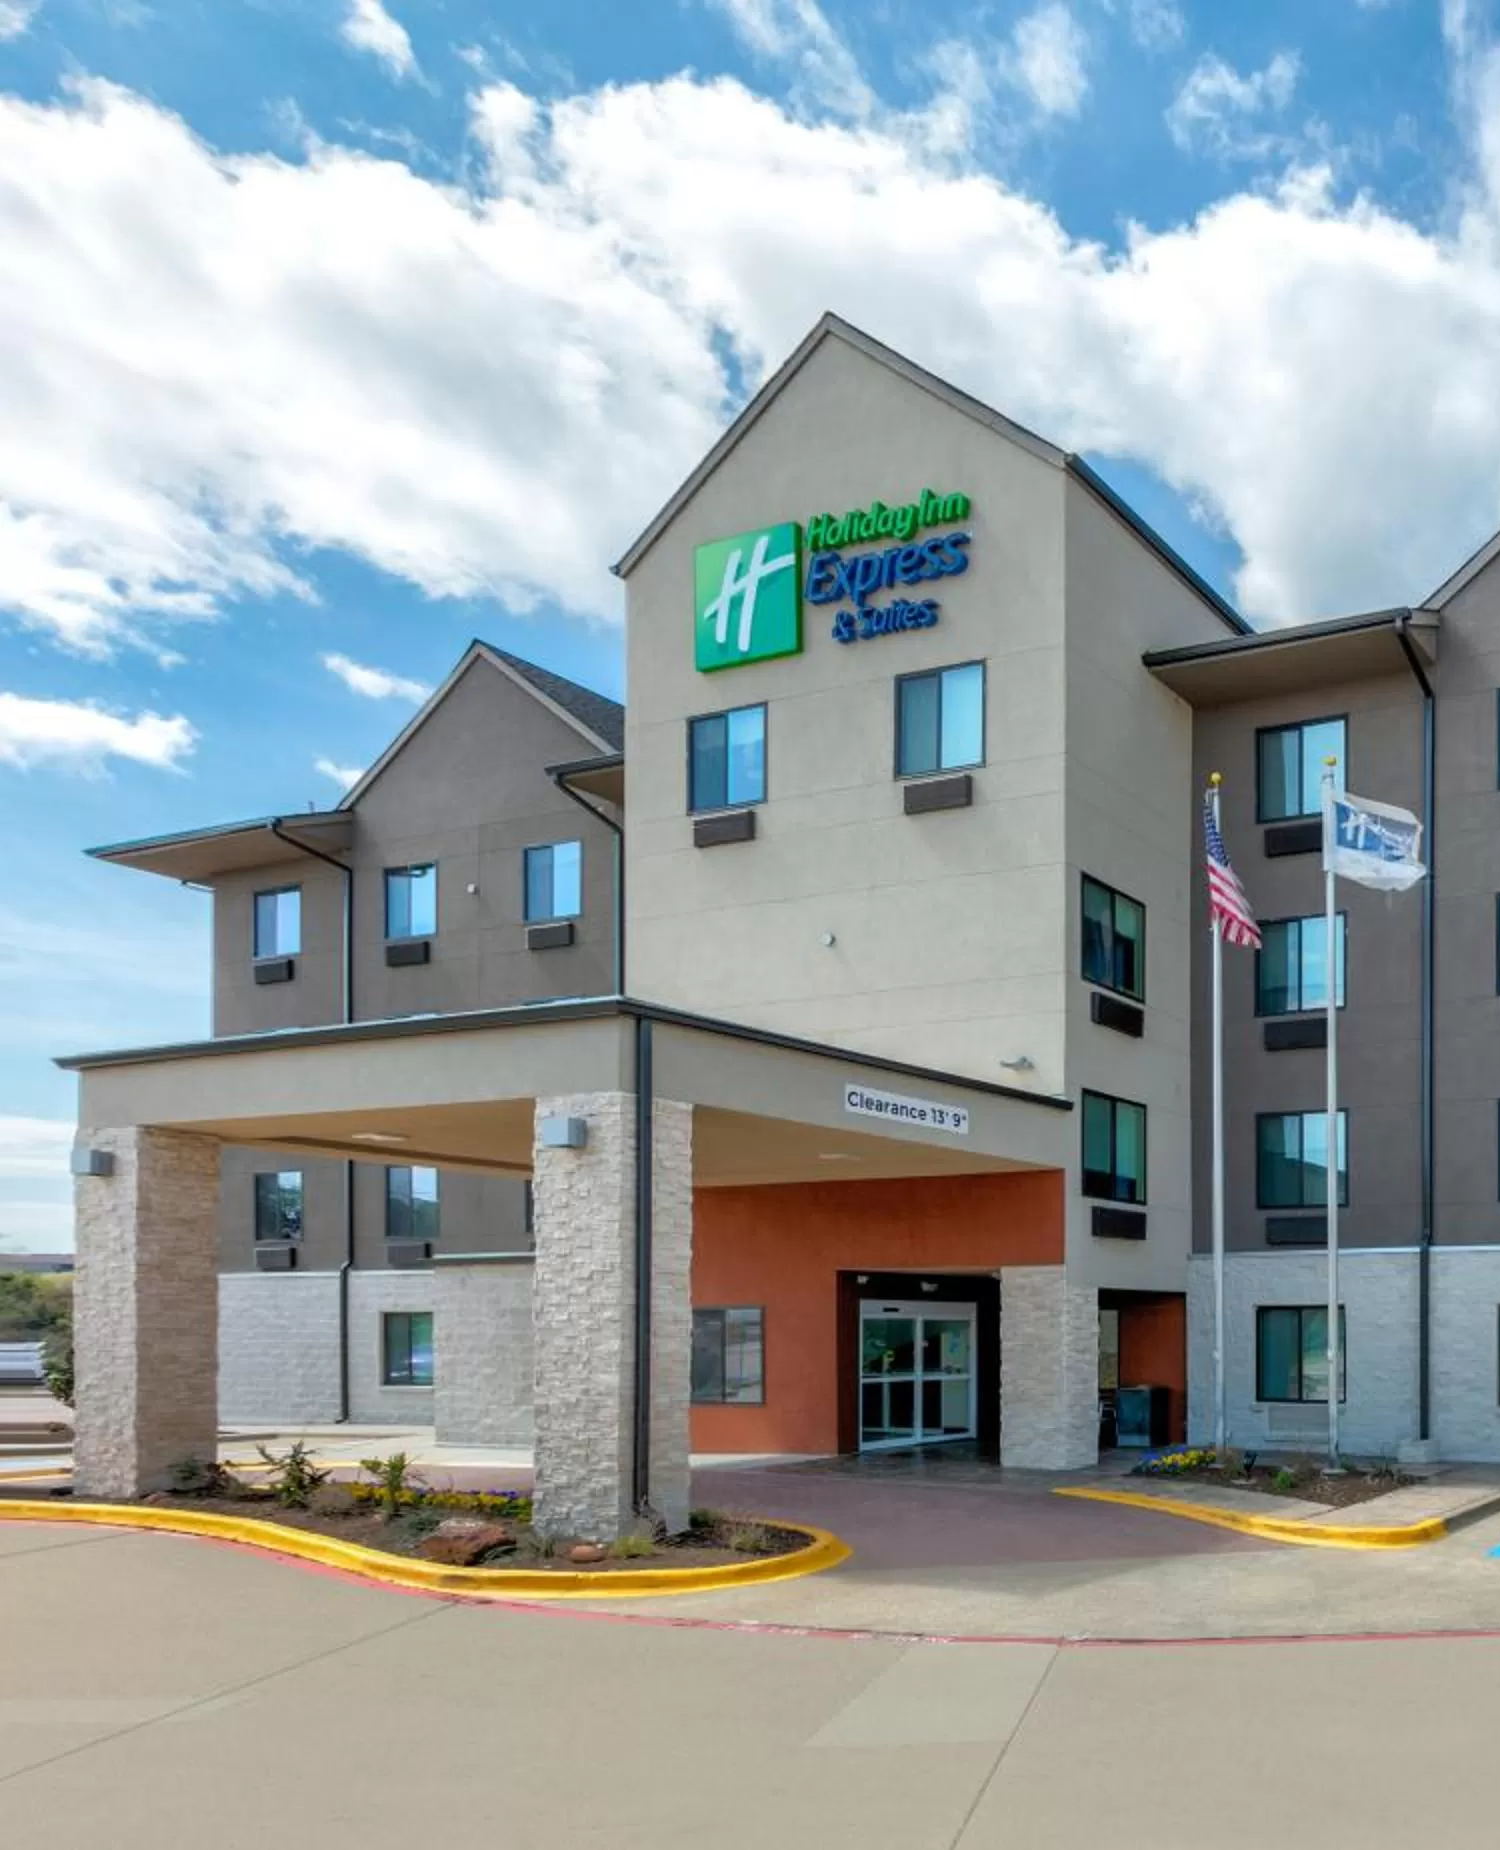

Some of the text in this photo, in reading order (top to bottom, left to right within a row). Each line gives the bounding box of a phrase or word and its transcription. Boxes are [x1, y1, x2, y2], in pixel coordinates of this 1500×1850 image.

[807, 487, 970, 551] Holiday Inn
[805, 531, 971, 608] Express
[832, 597, 941, 643] & Suites
[847, 1091, 927, 1121] Clearance
